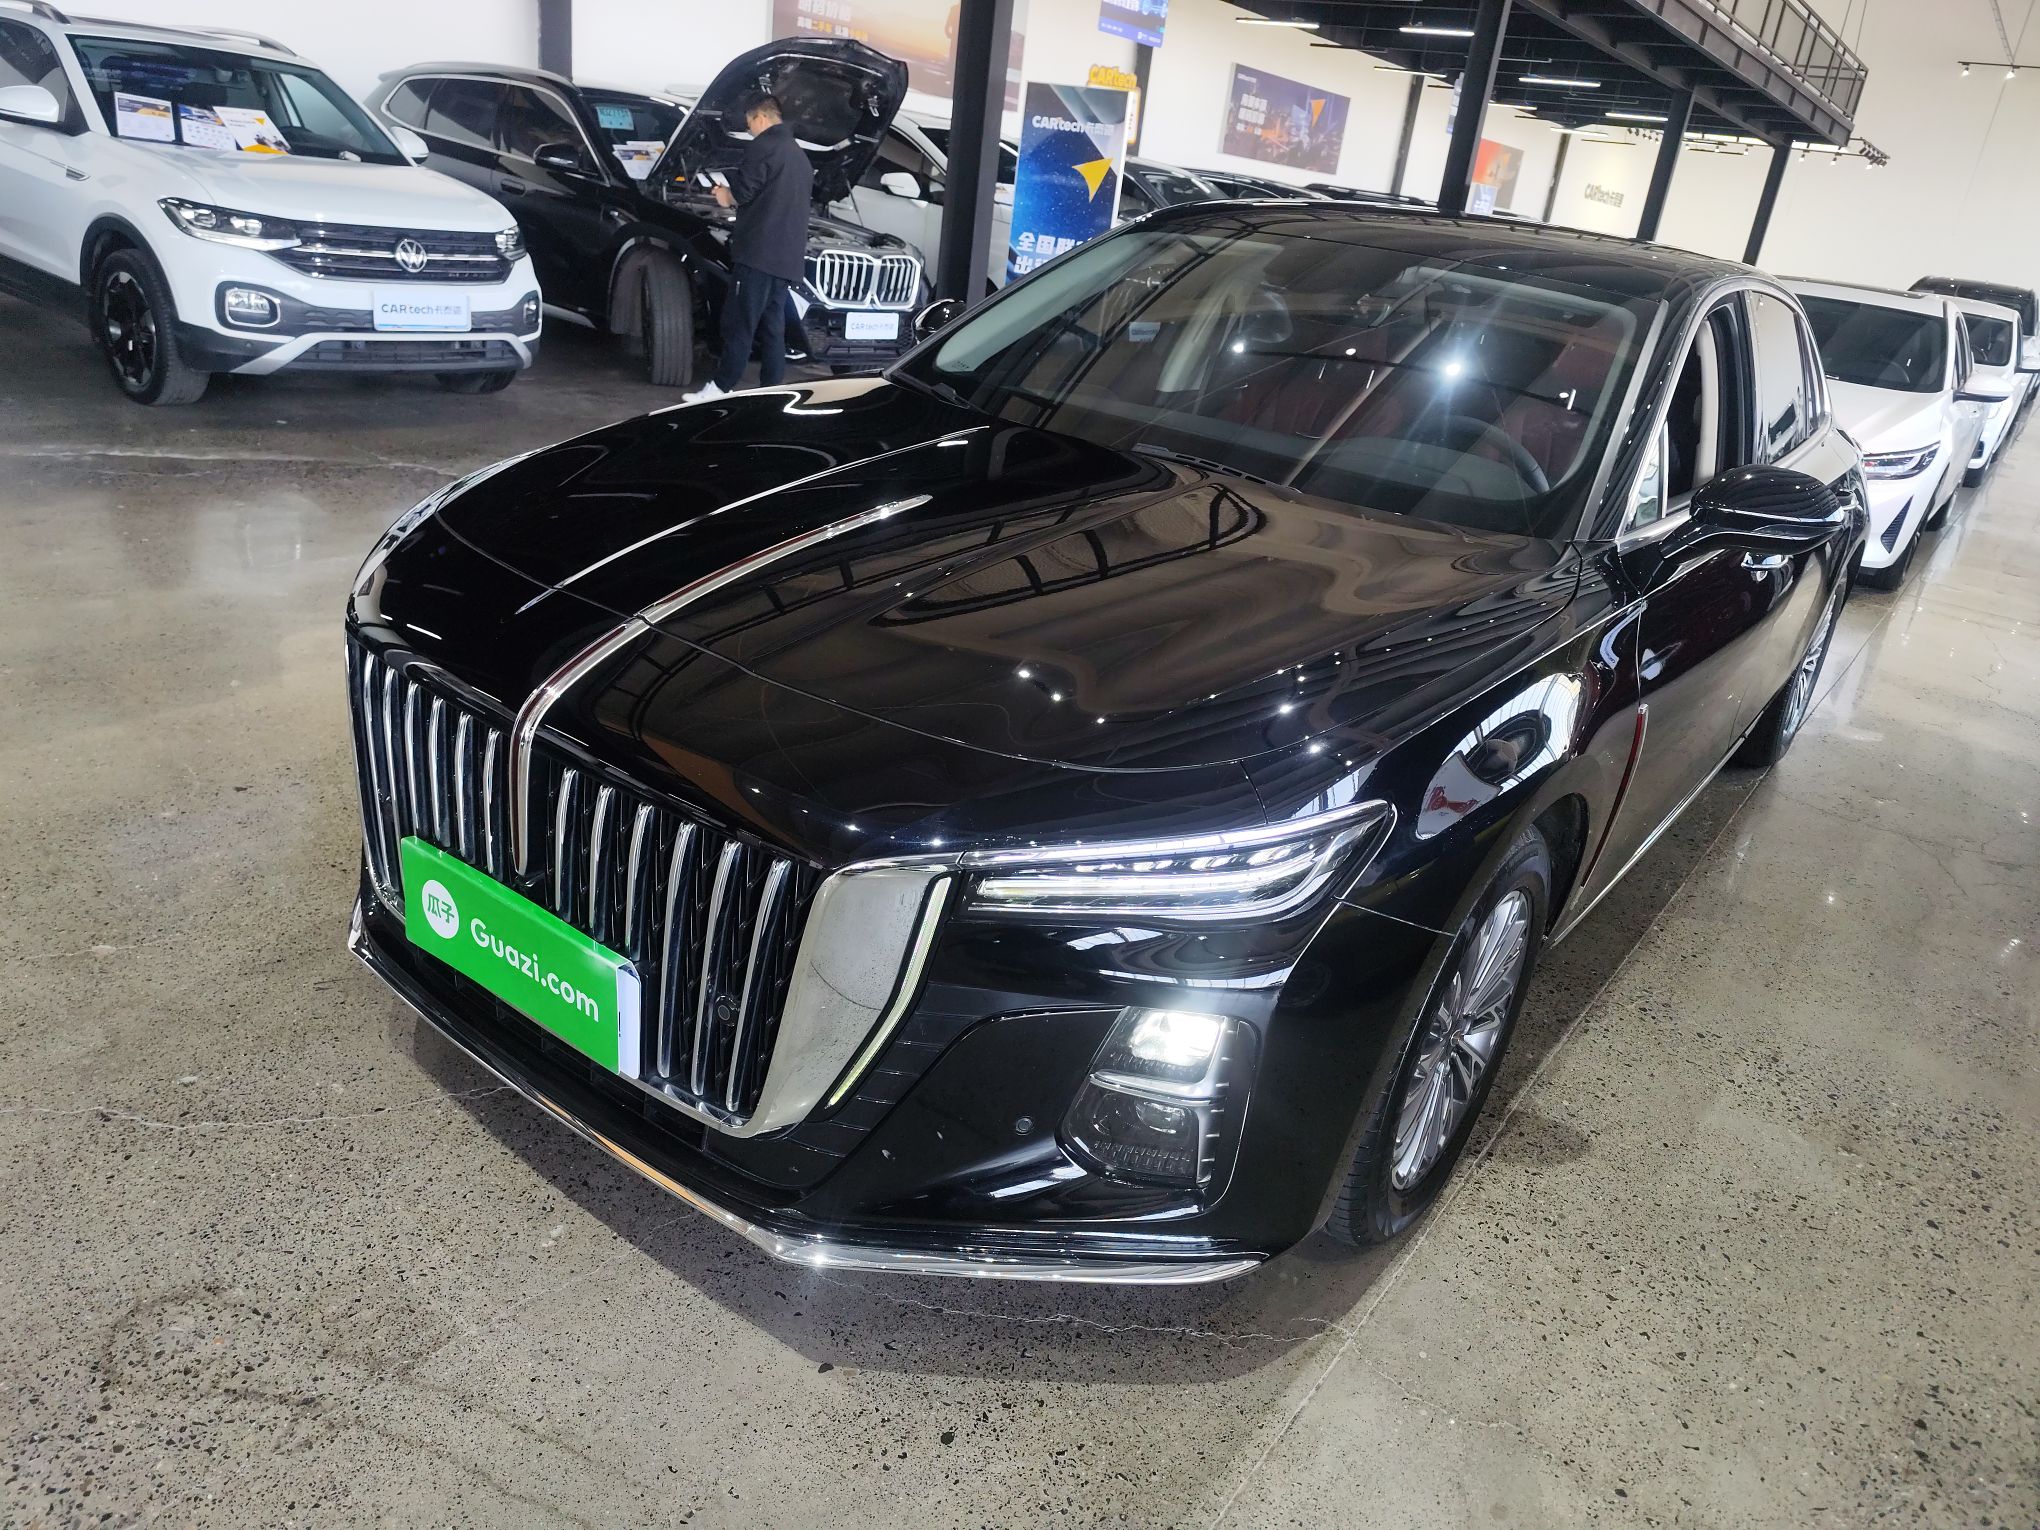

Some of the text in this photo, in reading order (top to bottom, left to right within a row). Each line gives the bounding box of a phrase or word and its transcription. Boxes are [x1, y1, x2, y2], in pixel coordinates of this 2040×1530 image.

[1016, 231, 1093, 255] 全国联
[427, 893, 455, 924] 瓜子
[470, 918, 599, 1022] Guazi.com
